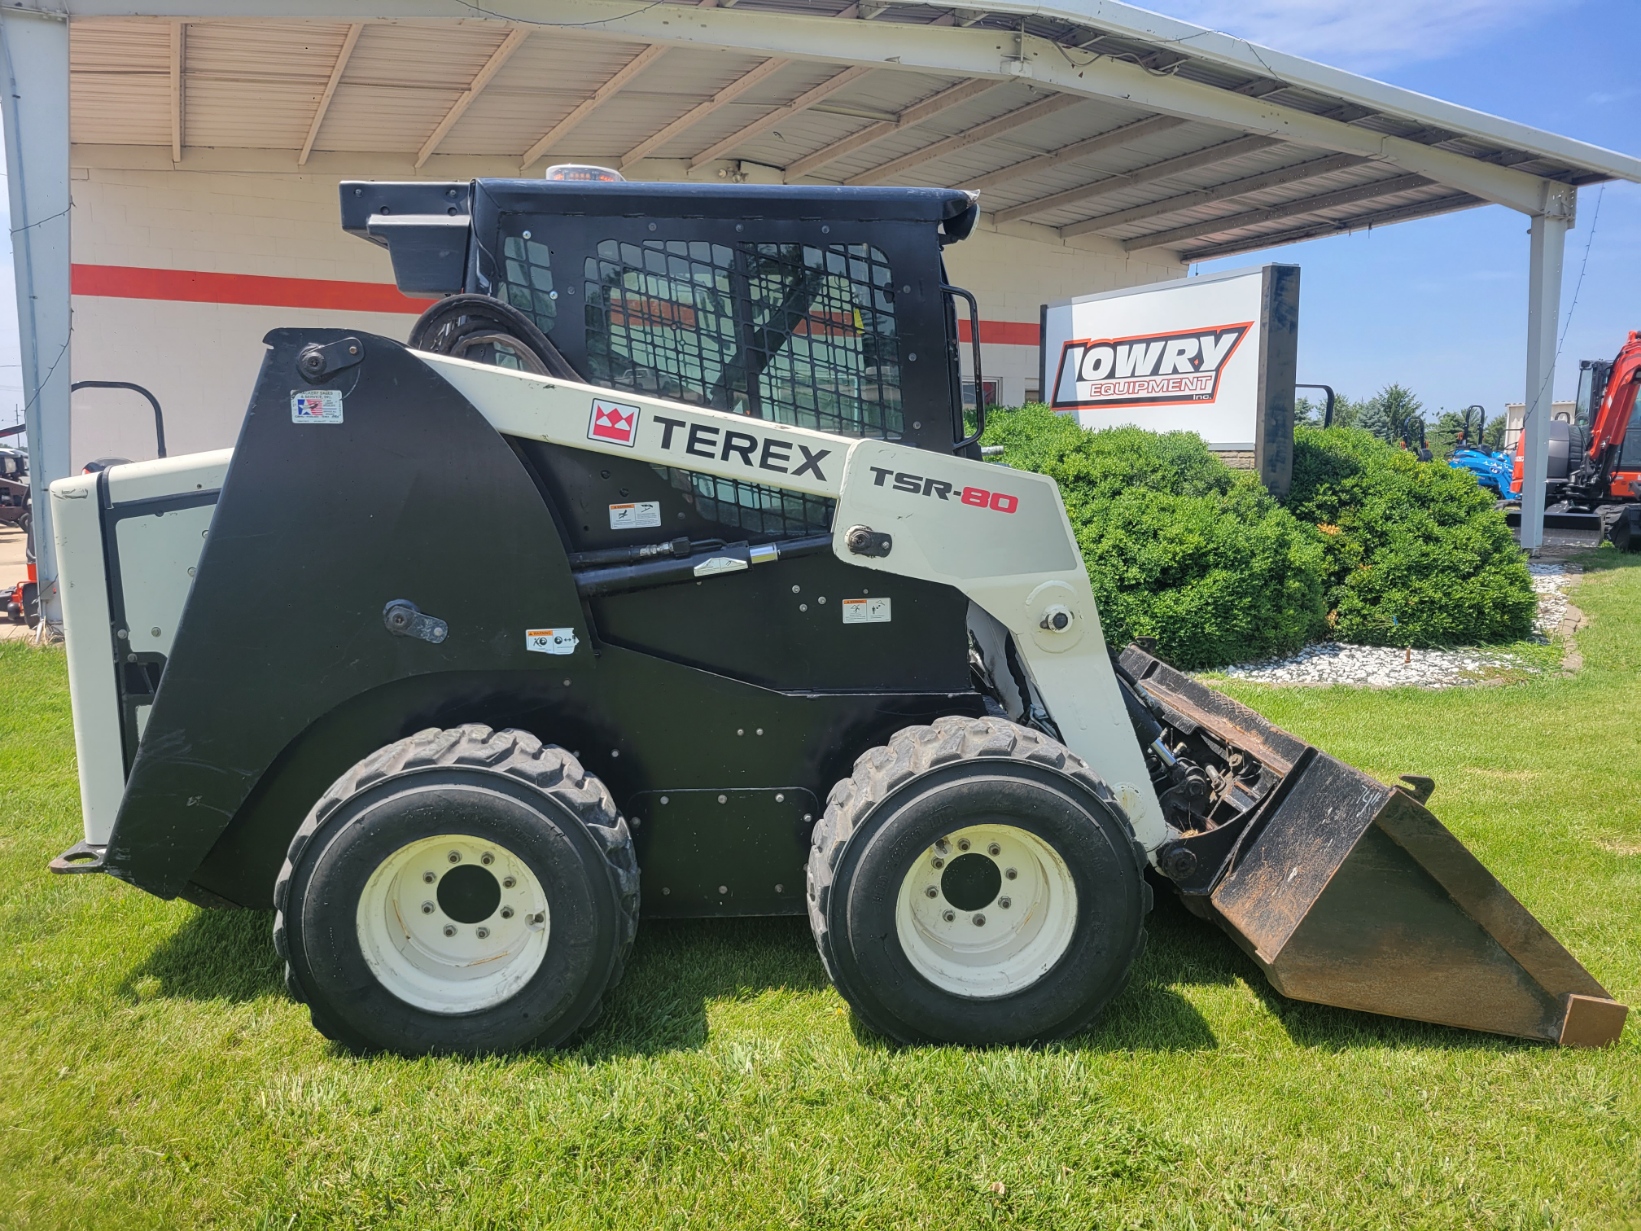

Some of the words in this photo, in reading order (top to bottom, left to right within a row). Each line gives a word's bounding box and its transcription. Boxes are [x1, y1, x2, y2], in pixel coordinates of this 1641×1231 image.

[1057, 332, 1238, 402] LOWRY
[1090, 376, 1213, 397] EQUIPMENT
[653, 415, 832, 482] TEREX
[870, 466, 1019, 514] TSR-80
